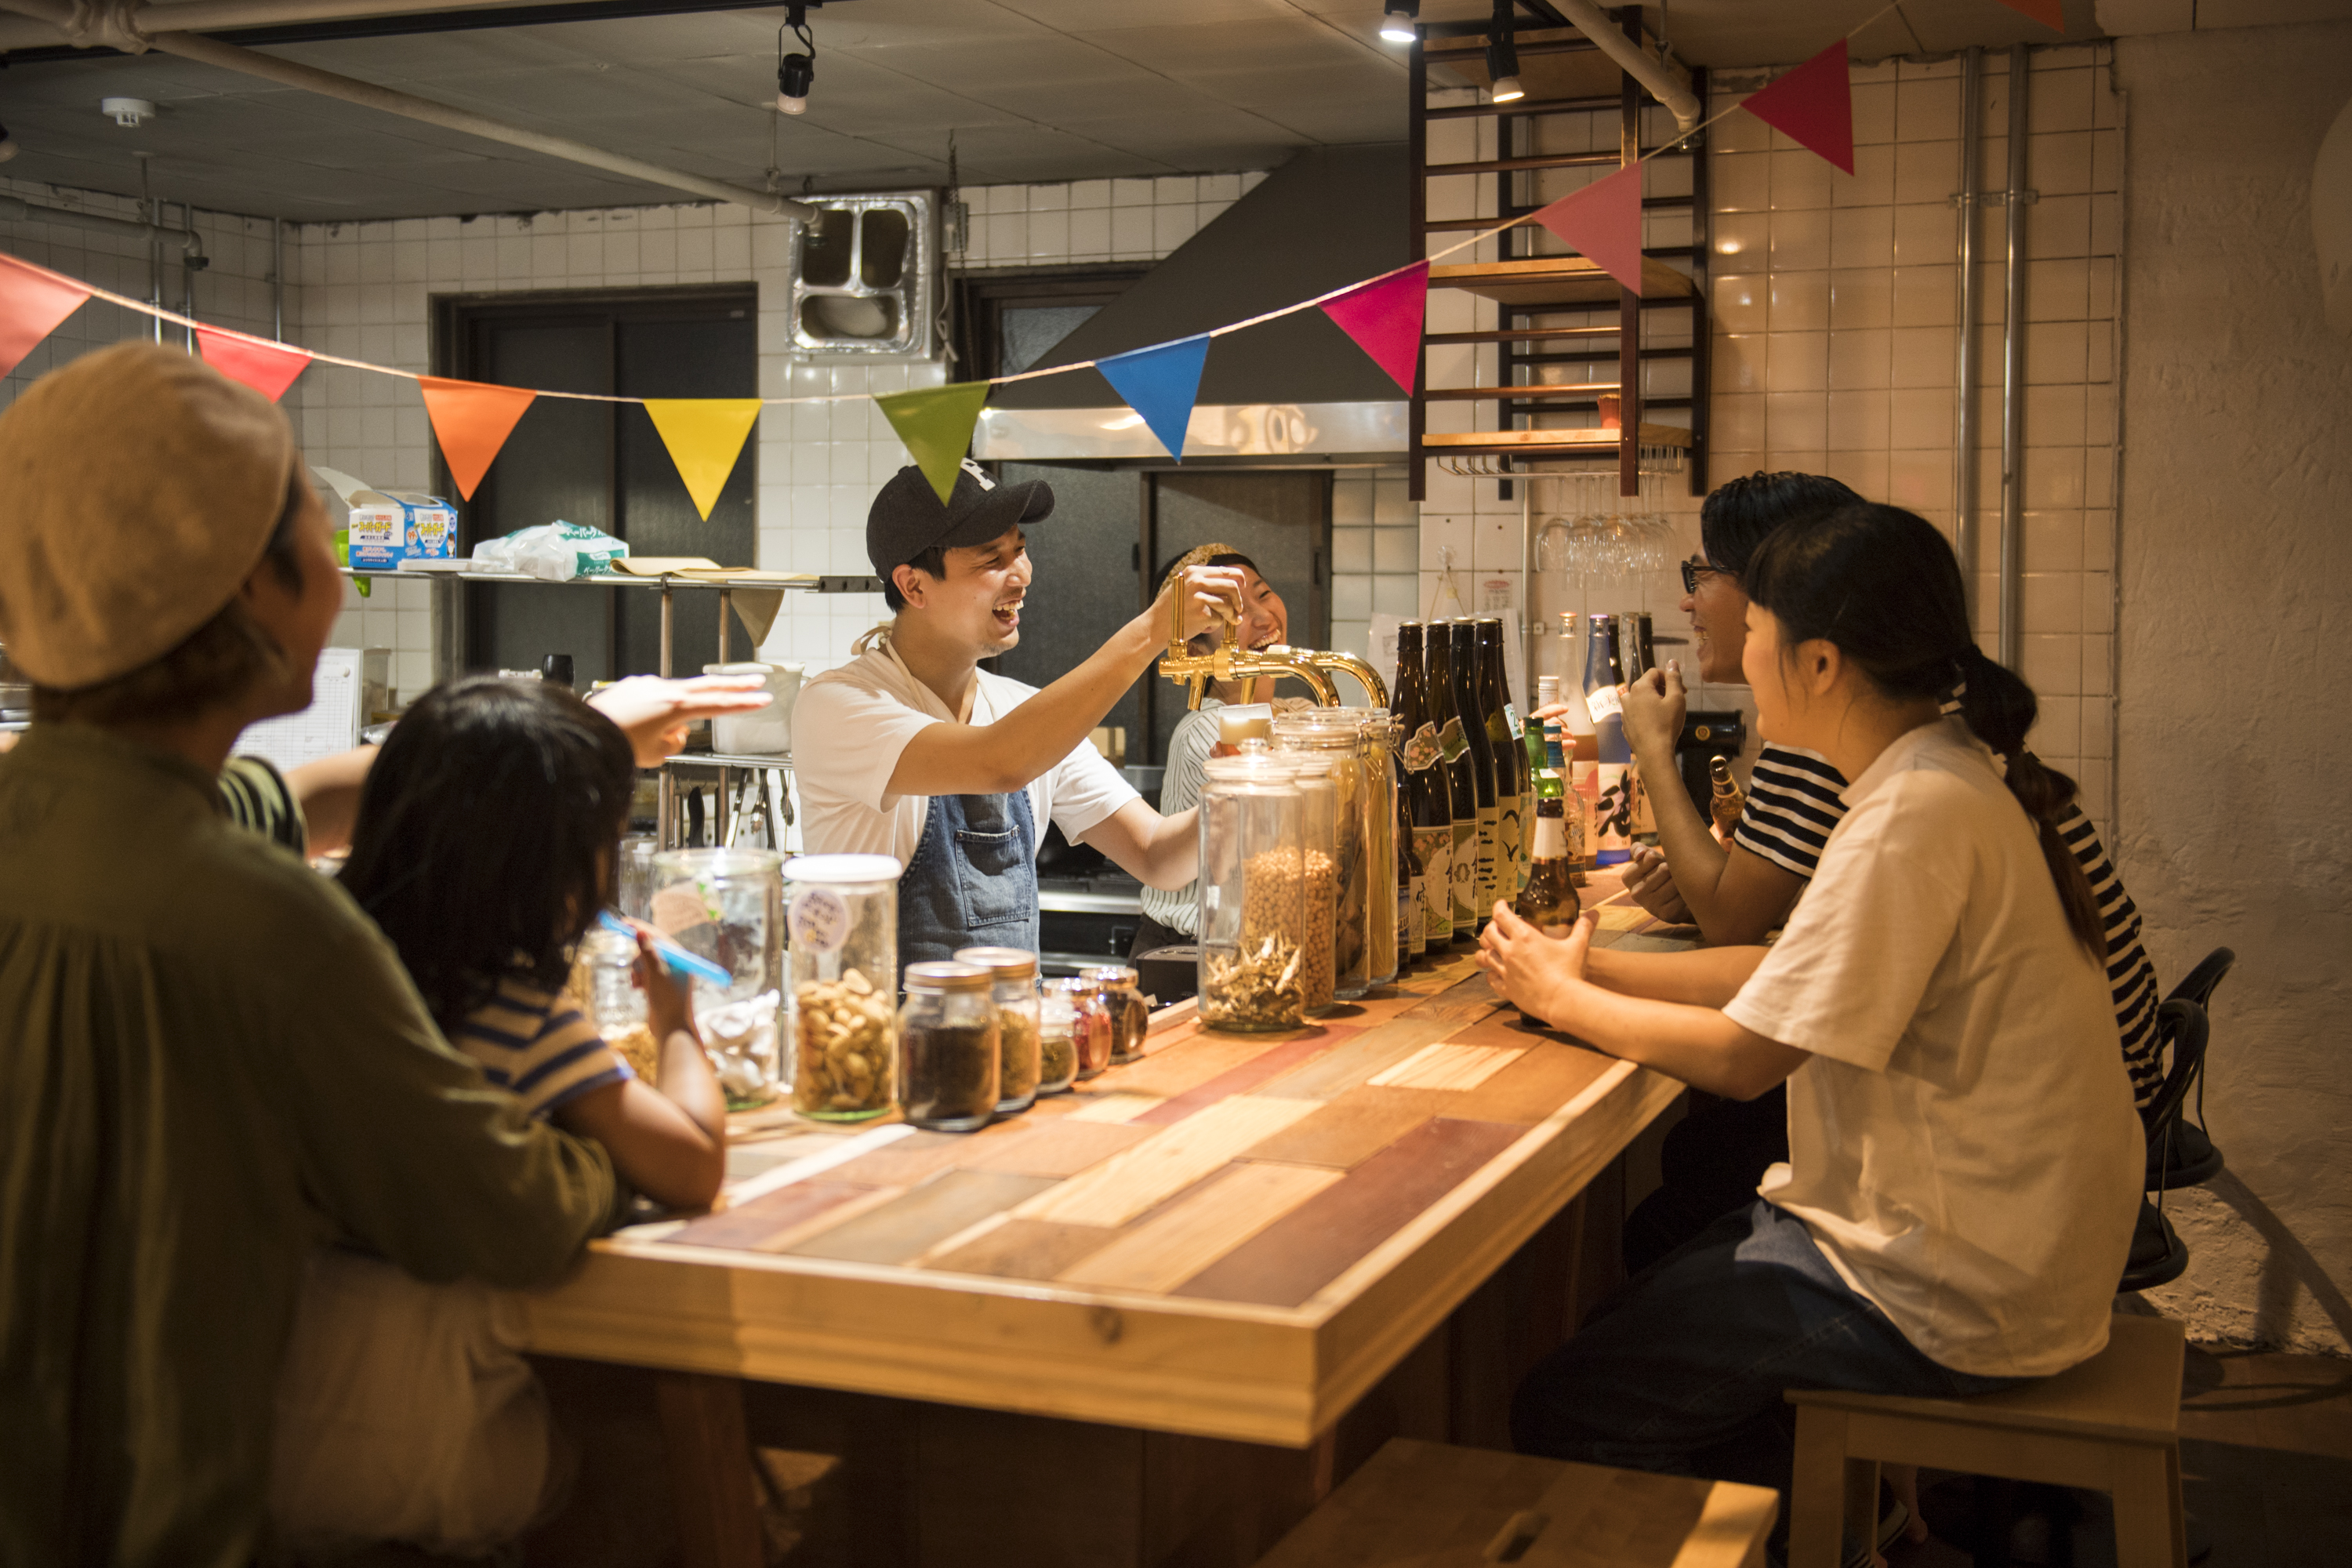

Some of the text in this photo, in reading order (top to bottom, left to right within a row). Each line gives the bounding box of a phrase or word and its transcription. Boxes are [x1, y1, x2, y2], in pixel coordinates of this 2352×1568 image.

[358, 521, 392, 532] スーパーガード
[420, 523, 445, 535] スーパーガード
